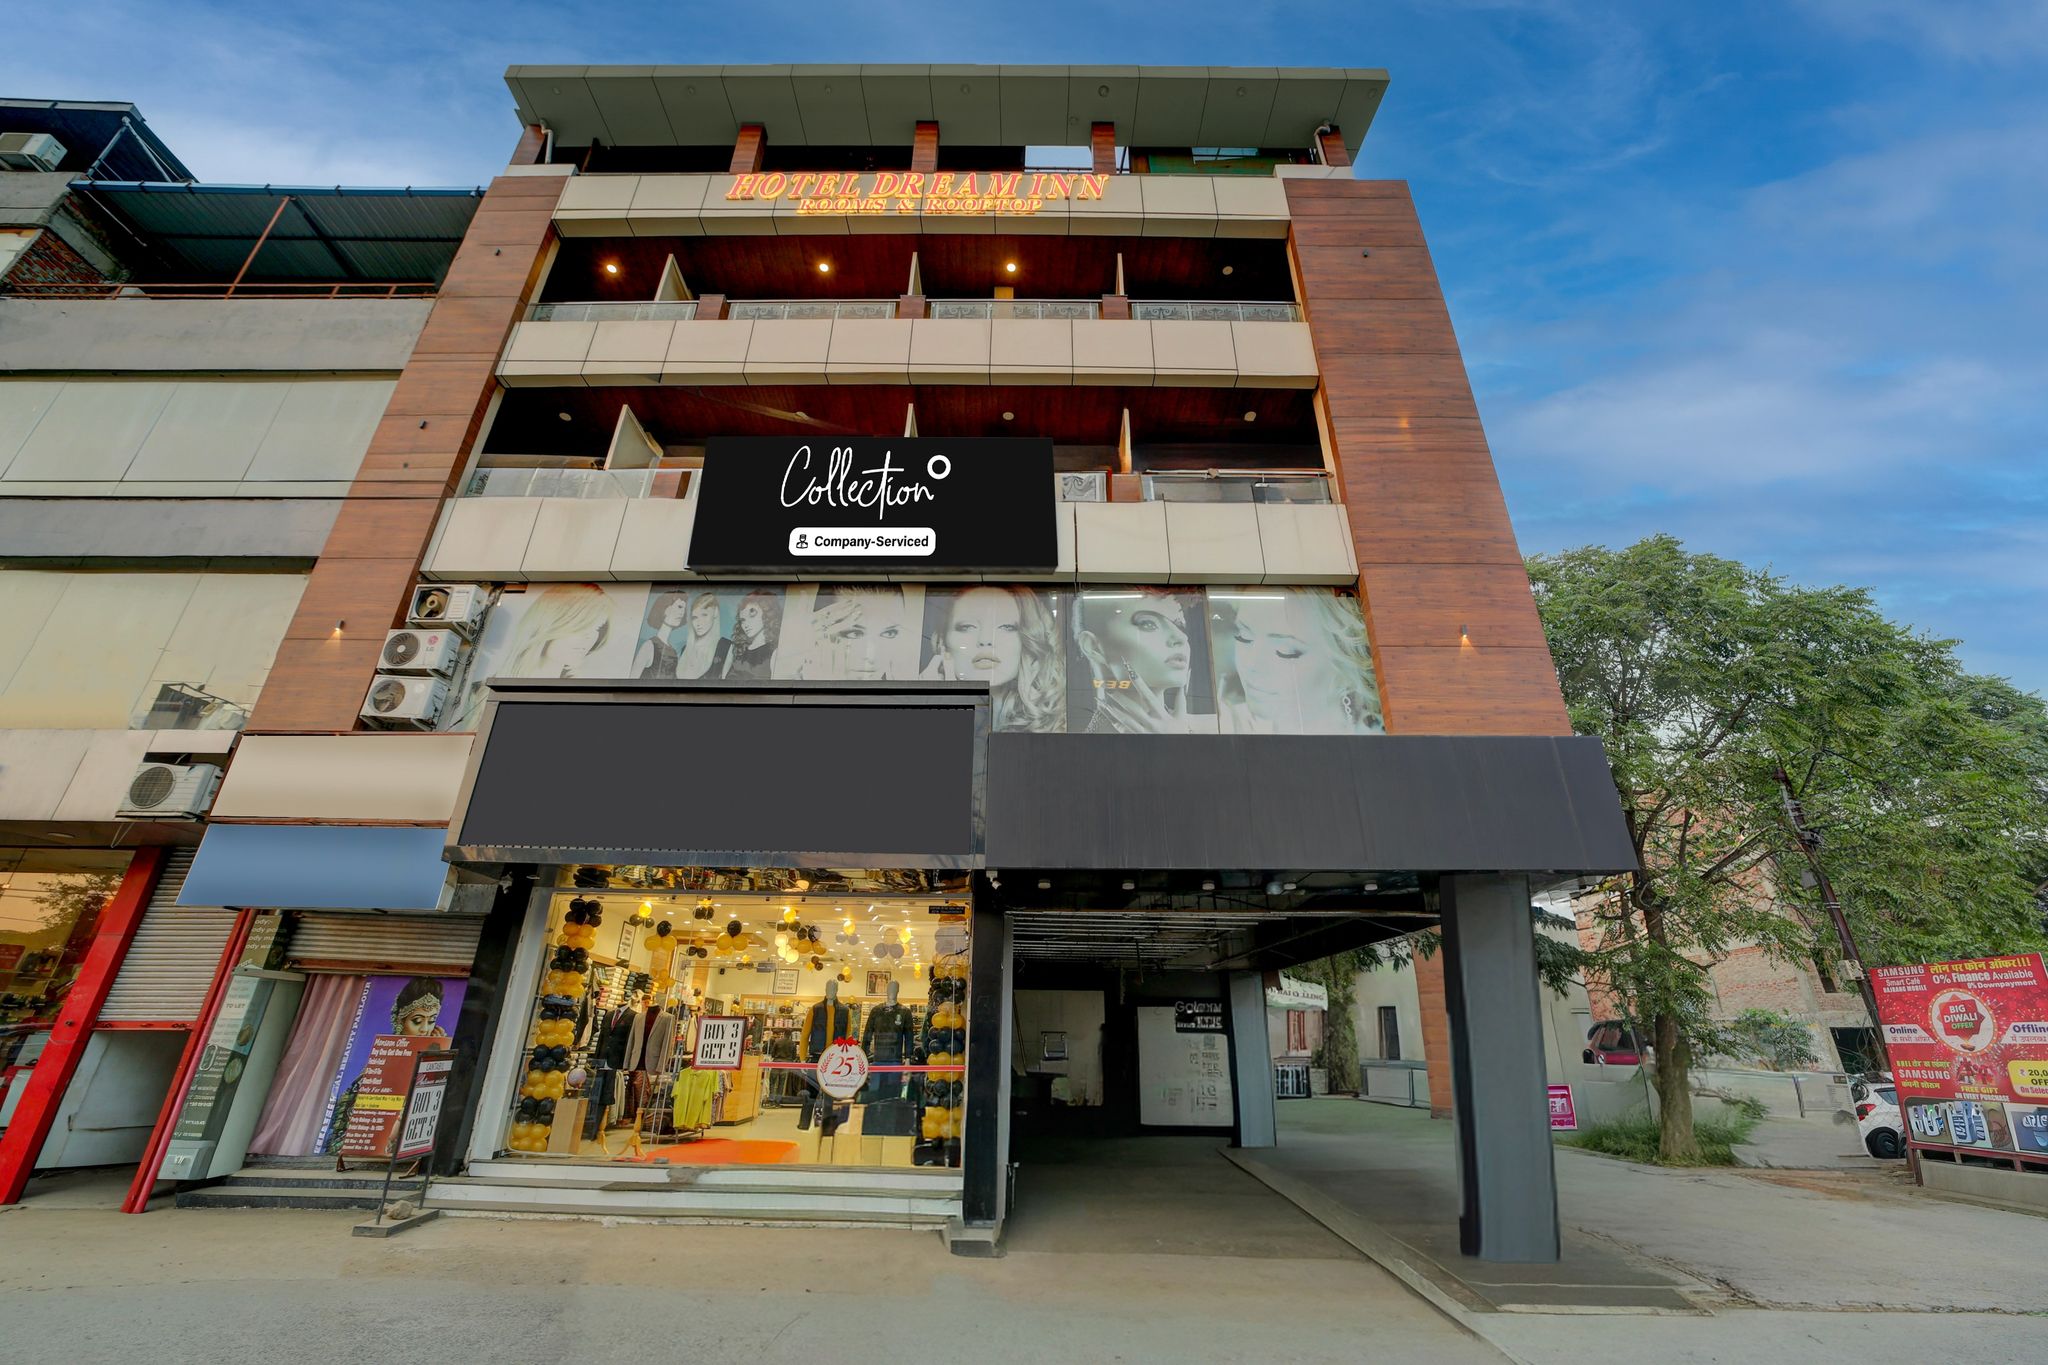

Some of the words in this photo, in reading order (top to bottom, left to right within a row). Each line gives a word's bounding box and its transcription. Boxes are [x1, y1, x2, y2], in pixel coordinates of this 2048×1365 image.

[726, 172, 862, 200] HOTEL
[868, 172, 1025, 199] DREAM
[1026, 174, 1109, 200] INN
[796, 198, 886, 215] ROOMS
[895, 199, 914, 214] &
[919, 198, 1044, 215] ROOFTOP
[780, 445, 935, 520] Collection
[814, 535, 930, 549] Company-Serviced
[1877, 965, 1924, 977] SAMSUNG
[1929, 962, 1949, 974] लोन
[1951, 963, 1963, 972] पर
[1964, 960, 1986, 971] फोन
[1886, 979, 1905, 987] Smart
[1905, 977, 1920, 986] Café
[1932, 973, 1951, 985] 0%
[1951, 972, 1991, 983] Finance
[1992, 970, 2034, 981] Available
[1977, 979, 2037, 989] Downpayment
[1949, 1004, 1966, 1013] BIG
[1943, 1012, 1977, 1023] DIWALI
[341, 1030, 357, 1071] BEAUTY
[353, 981, 372, 1030] PARLOUR
[704, 1023, 727, 1039] BUY
[731, 1023, 739, 1038] 3
[1889, 1026, 1917, 1034] Online
[1951, 1022, 1974, 1030] OFFER
[396, 1038, 410, 1047] Offer
[701, 1043, 725, 1059] GET
[729, 1042, 737, 1057] 5
[831, 1056, 854, 1077] 25
[1898, 1069, 1951, 1080] SAMSUNG
[412, 1091, 431, 1115] BUY
[433, 1090, 442, 1111] 3
[406, 1118, 426, 1140] GET
[427, 1116, 436, 1137] 5
